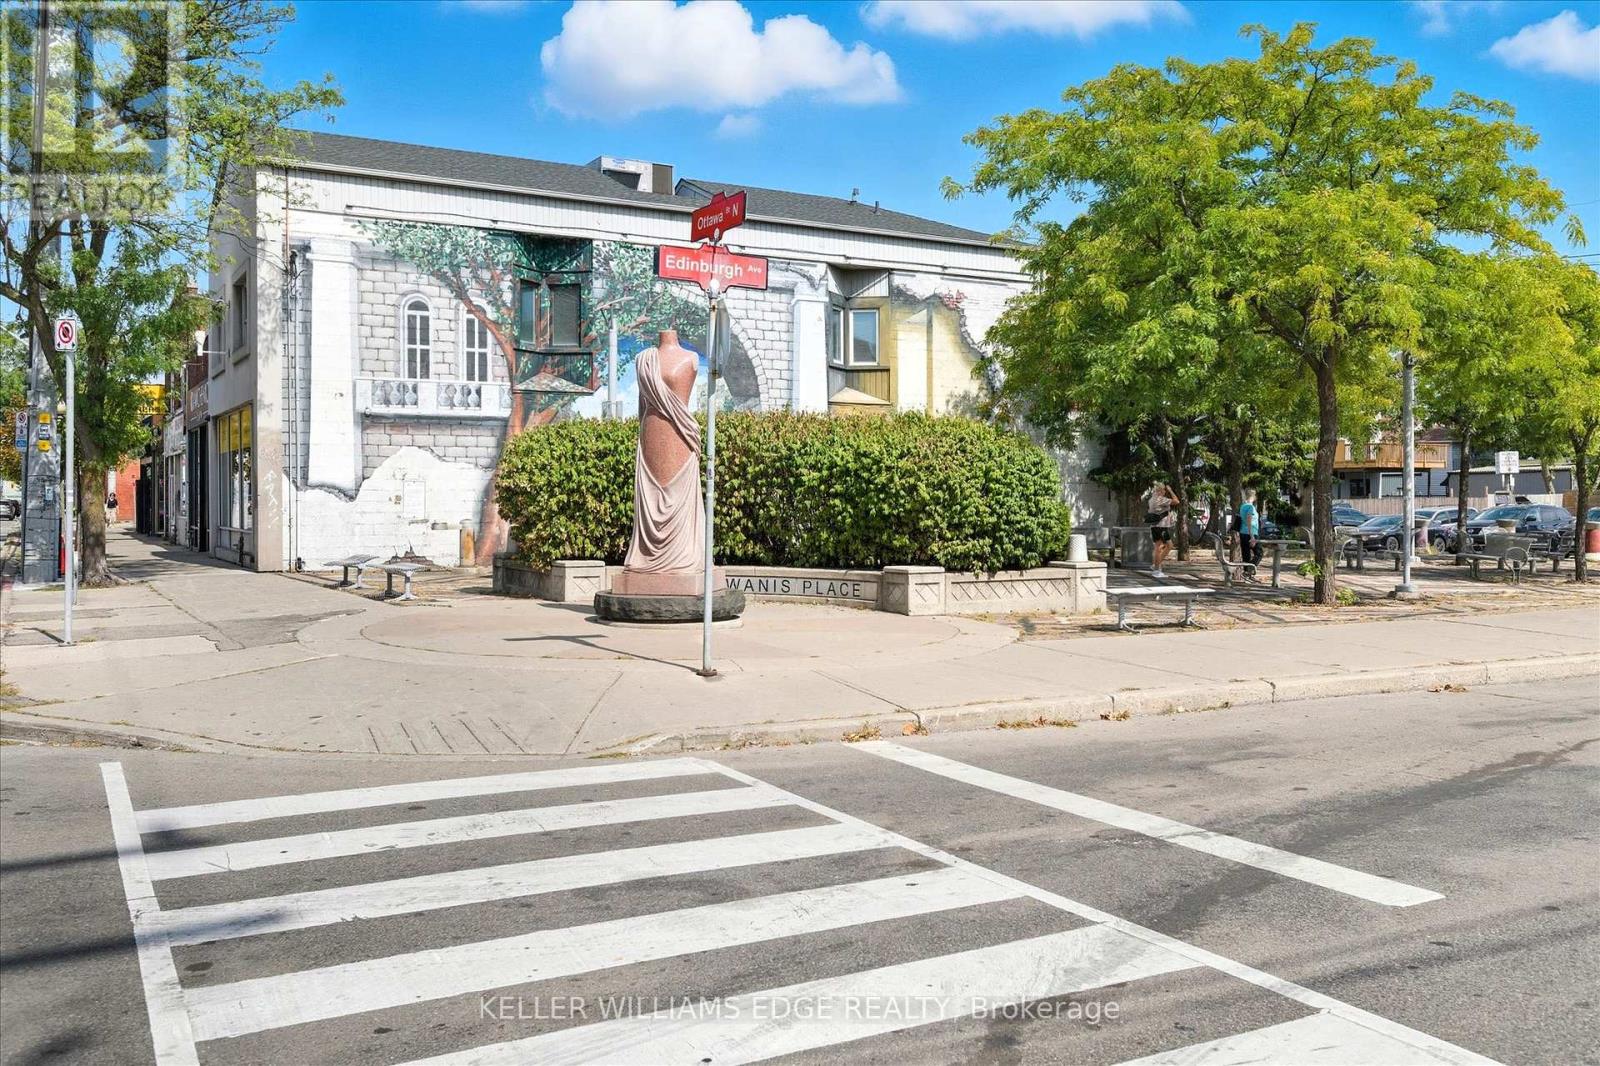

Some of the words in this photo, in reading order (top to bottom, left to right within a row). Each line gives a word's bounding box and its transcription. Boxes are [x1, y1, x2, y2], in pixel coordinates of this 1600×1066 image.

[697, 212, 723, 230] Ottawa
[732, 202, 739, 217] N
[665, 254, 743, 279] Edinburgh
[747, 264, 762, 273] Ave
[725, 578, 791, 593] WANIS
[802, 580, 861, 597] PLACE
